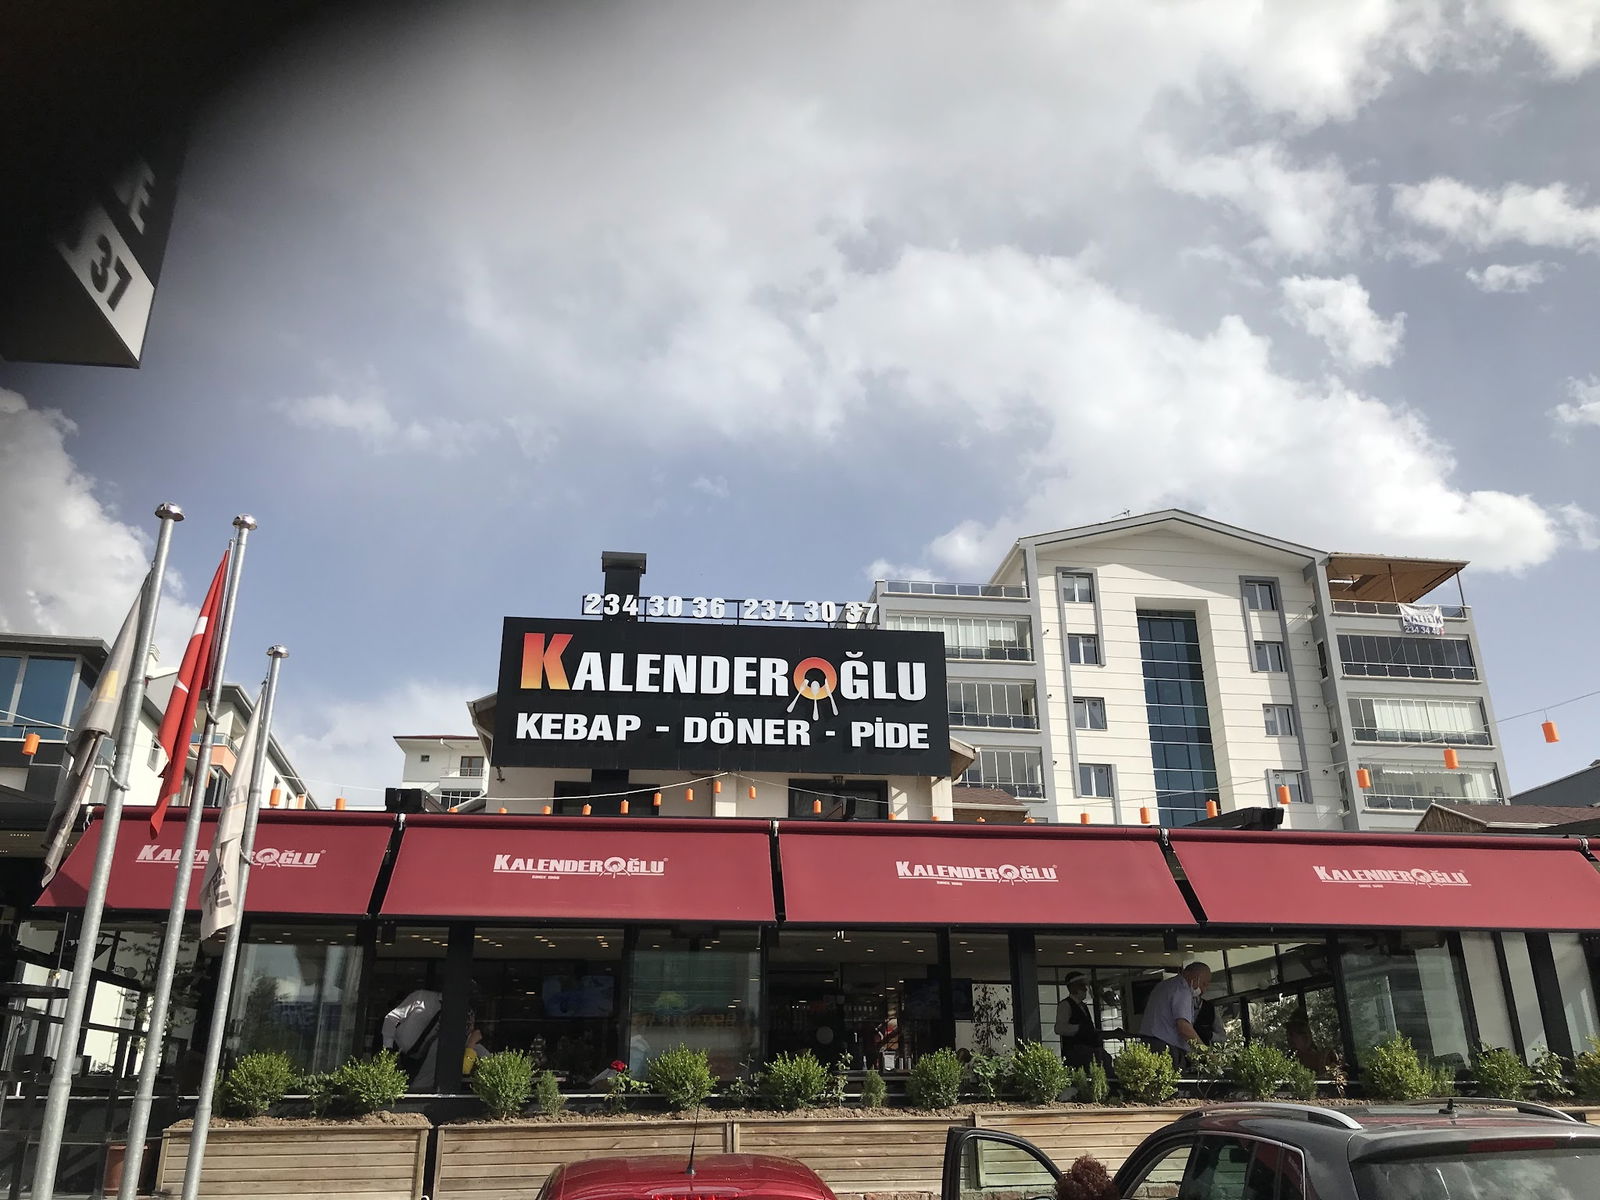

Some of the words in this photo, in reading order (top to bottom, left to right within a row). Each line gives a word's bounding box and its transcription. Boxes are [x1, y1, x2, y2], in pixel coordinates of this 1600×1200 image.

[583, 593, 639, 616] 234
[649, 595, 683, 617] 30
[692, 597, 726, 619] 36
[743, 599, 794, 621] 234
[803, 600, 837, 622] 30
[845, 602, 878, 624] 37
[520, 632, 927, 702] KALENDEROĞLU
[516, 712, 642, 741] KEBAP
[683, 711, 811, 746] DÖNER
[851, 717, 930, 749] PİDE
[493, 854, 665, 876] KALENDEROĞLU
[895, 861, 1058, 881] KALENDEROĞLU
[1312, 865, 1469, 885] KALENDEROĞLU
